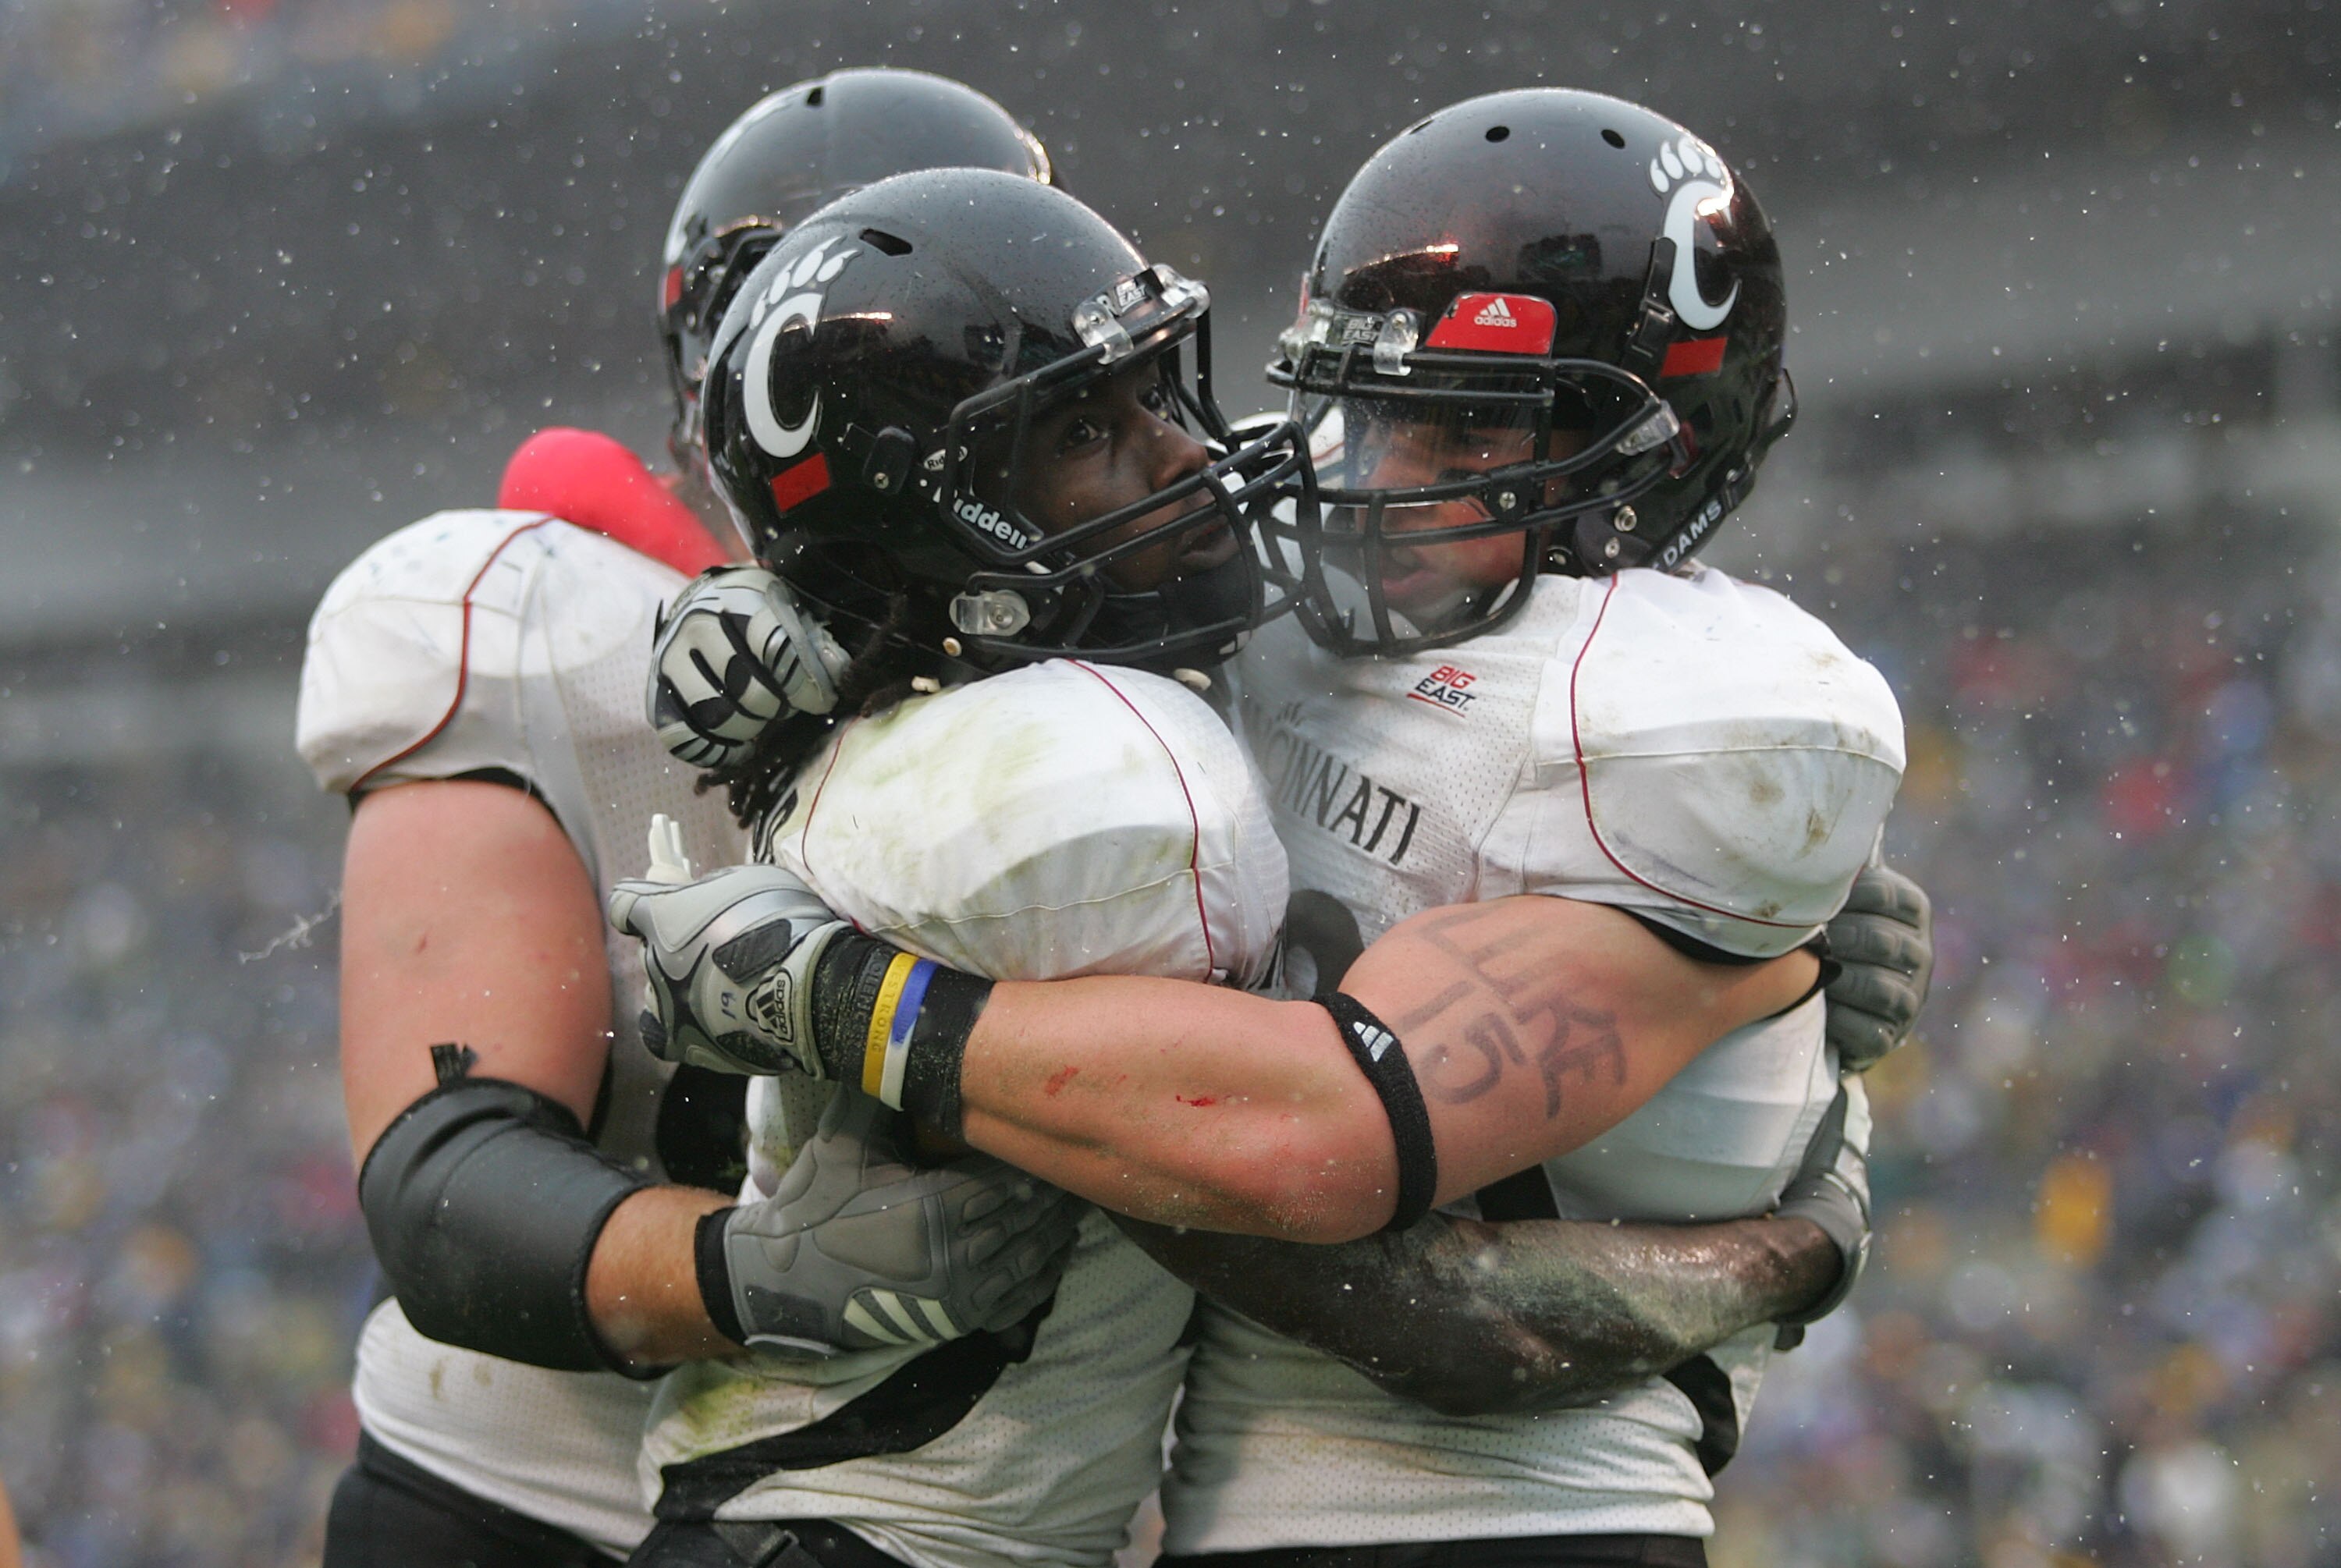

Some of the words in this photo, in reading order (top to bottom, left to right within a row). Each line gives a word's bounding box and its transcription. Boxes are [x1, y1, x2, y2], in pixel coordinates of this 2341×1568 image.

[1473, 315, 1517, 328] adidas
[1653, 500, 1721, 569] DAMS
[1415, 678, 1476, 708] EAST
[1430, 665, 1476, 690] BIG
[774, 979, 788, 1035] adidas
[1394, 980, 1525, 1105] 15
